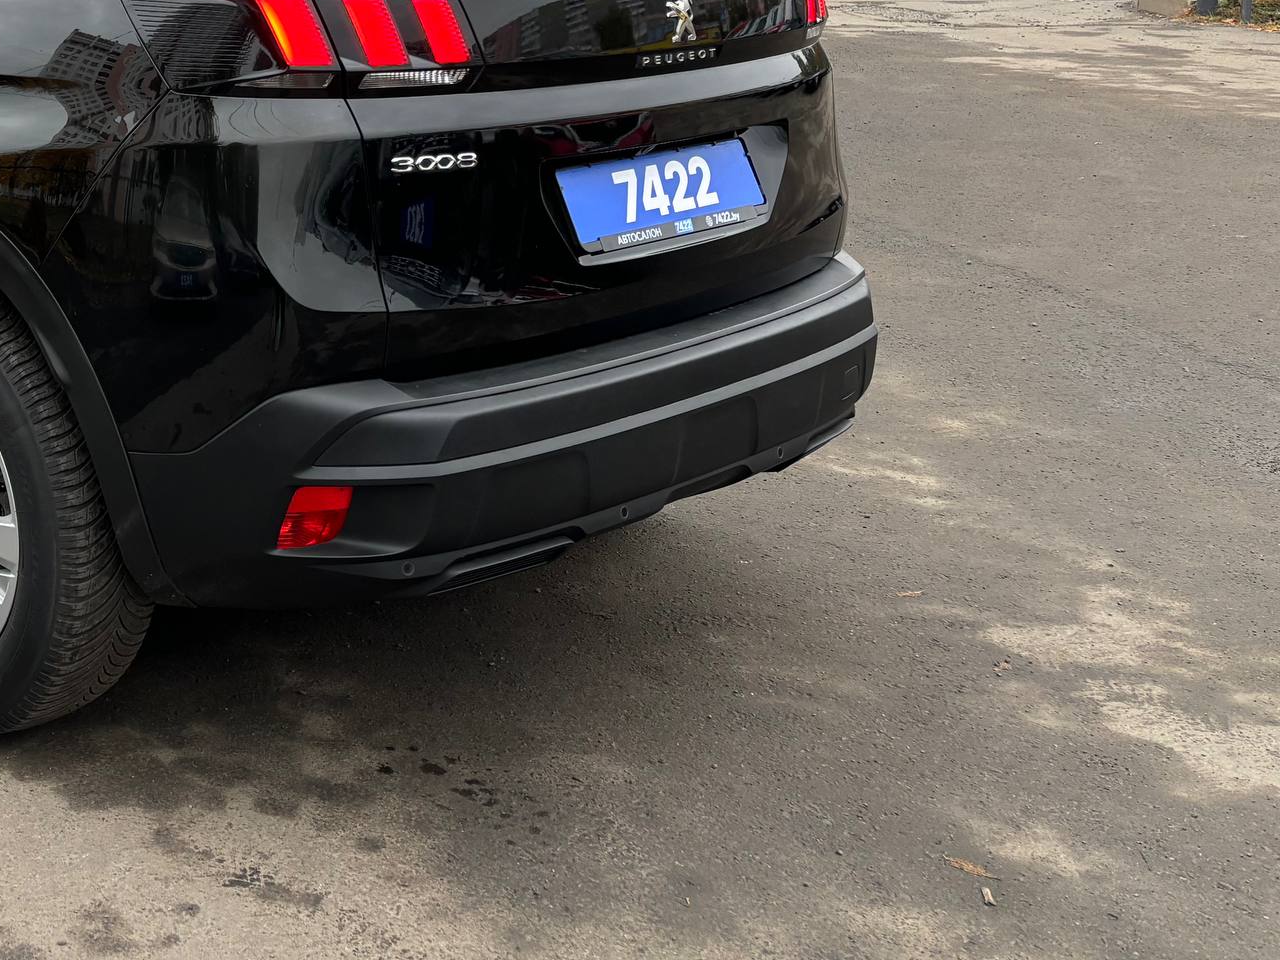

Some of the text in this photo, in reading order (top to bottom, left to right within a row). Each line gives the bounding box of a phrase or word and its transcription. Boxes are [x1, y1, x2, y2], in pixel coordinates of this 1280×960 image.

[641, 48, 717, 67] PEUGEOT
[390, 152, 478, 172] 3008
[611, 155, 720, 224] 7422
[617, 226, 663, 245] АВТОСАЛОН
[674, 219, 693, 232] 7422
